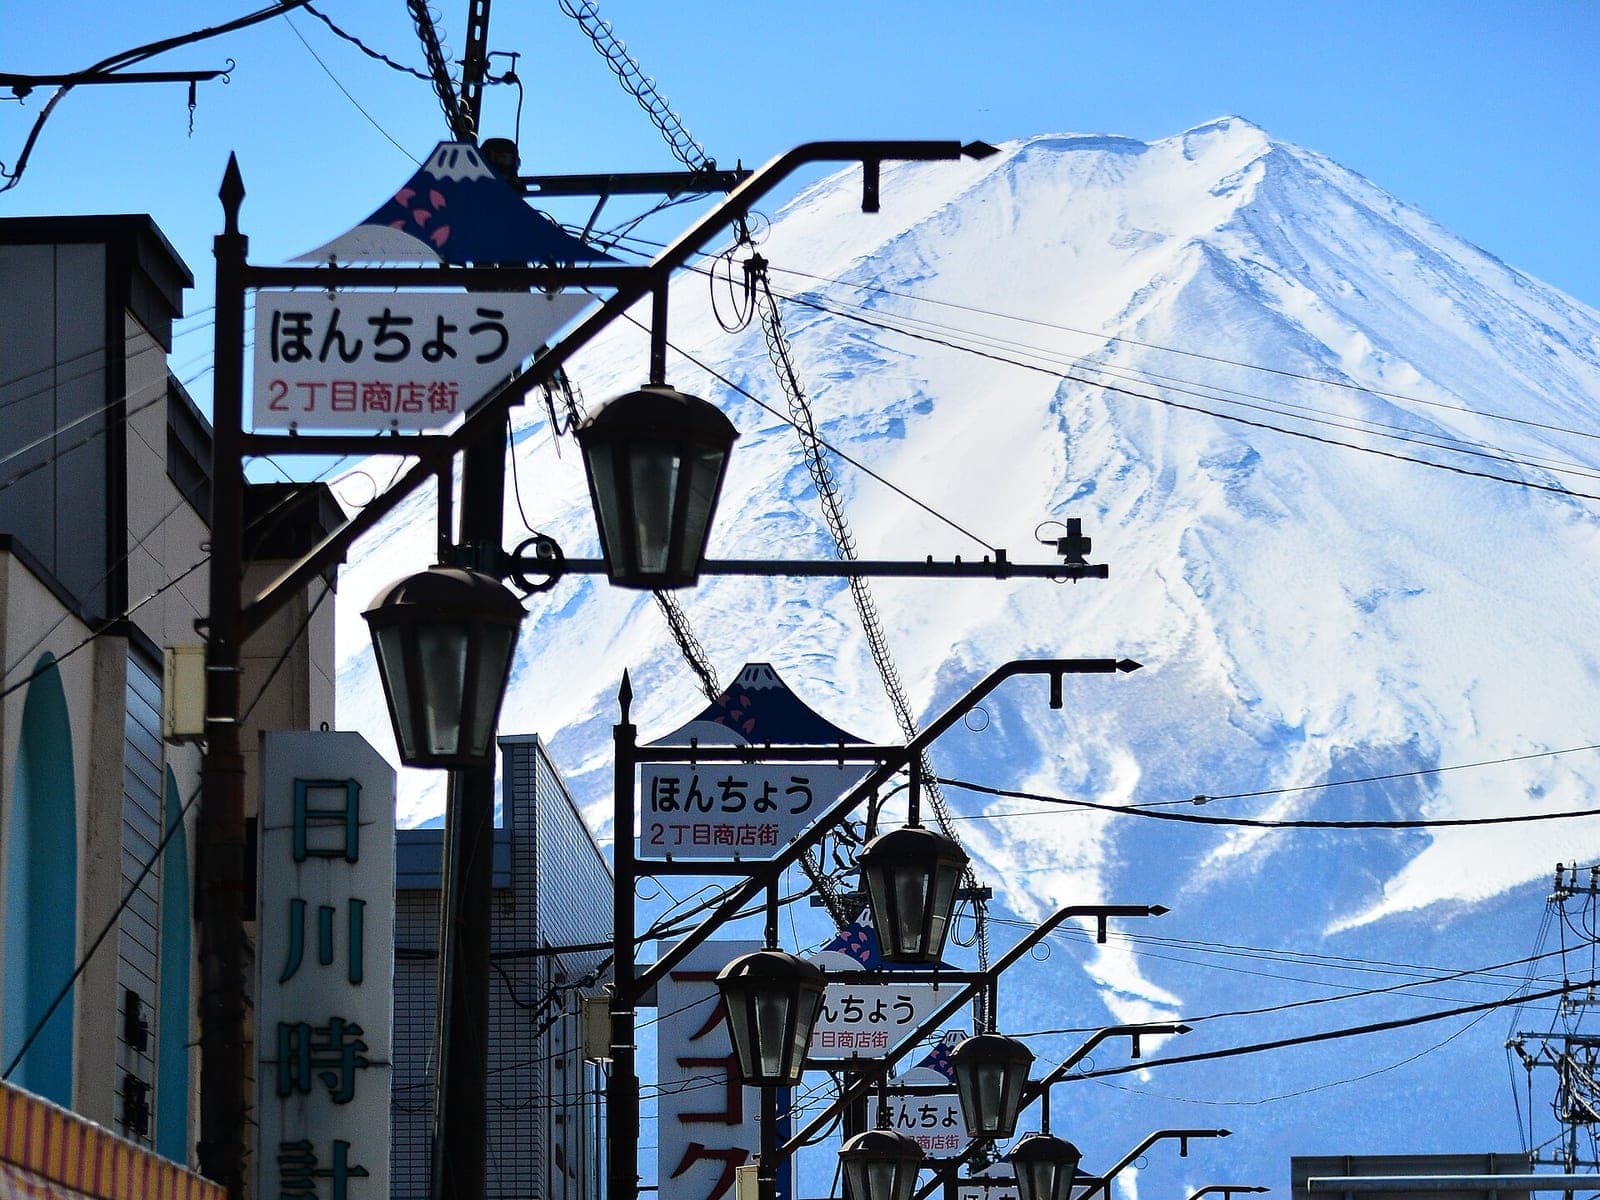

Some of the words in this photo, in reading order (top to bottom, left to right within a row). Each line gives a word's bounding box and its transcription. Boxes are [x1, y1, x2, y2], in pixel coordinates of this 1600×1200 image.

[269, 306, 512, 366] ほんちょう
[267, 379, 460, 414] 2丁目商店街
[650, 774, 815, 814] ほんちょう
[649, 821, 780, 848] 2丁目商店街
